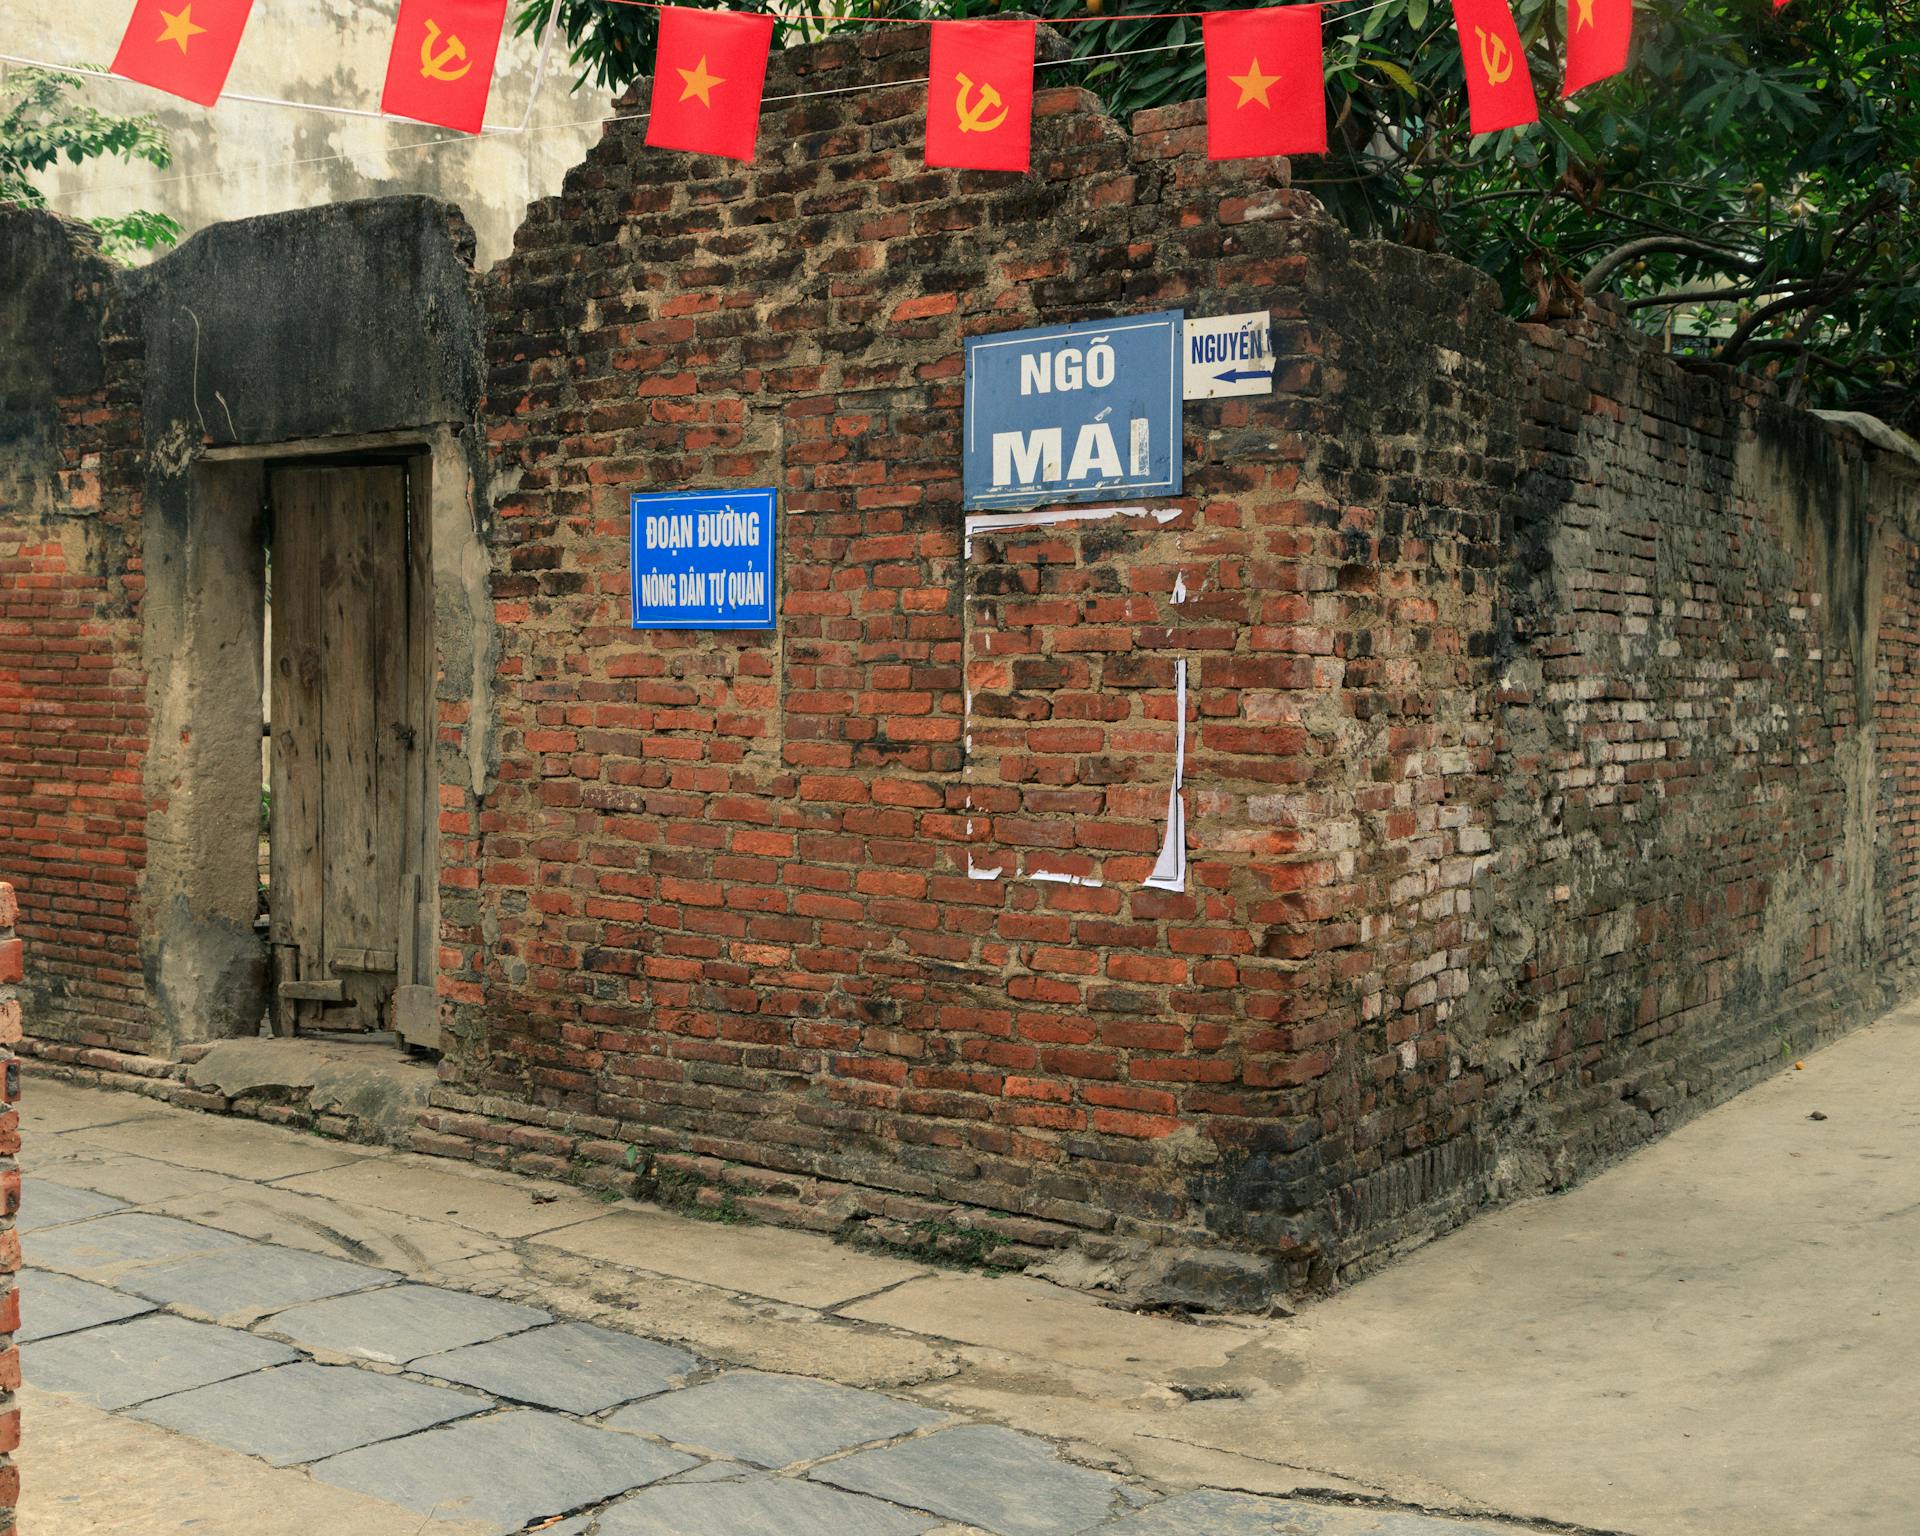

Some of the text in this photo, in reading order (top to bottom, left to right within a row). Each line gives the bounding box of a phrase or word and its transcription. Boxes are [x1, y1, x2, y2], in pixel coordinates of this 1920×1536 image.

[1020, 335, 1115, 396] NGÕ
[1191, 320, 1263, 365] NGUYỄN
[992, 406, 1149, 487] MÁI
[646, 505, 760, 556] ĐOẠN ĐƯỜNG
[642, 560, 765, 614] NÔNG DÂN TỰ QUẢN
